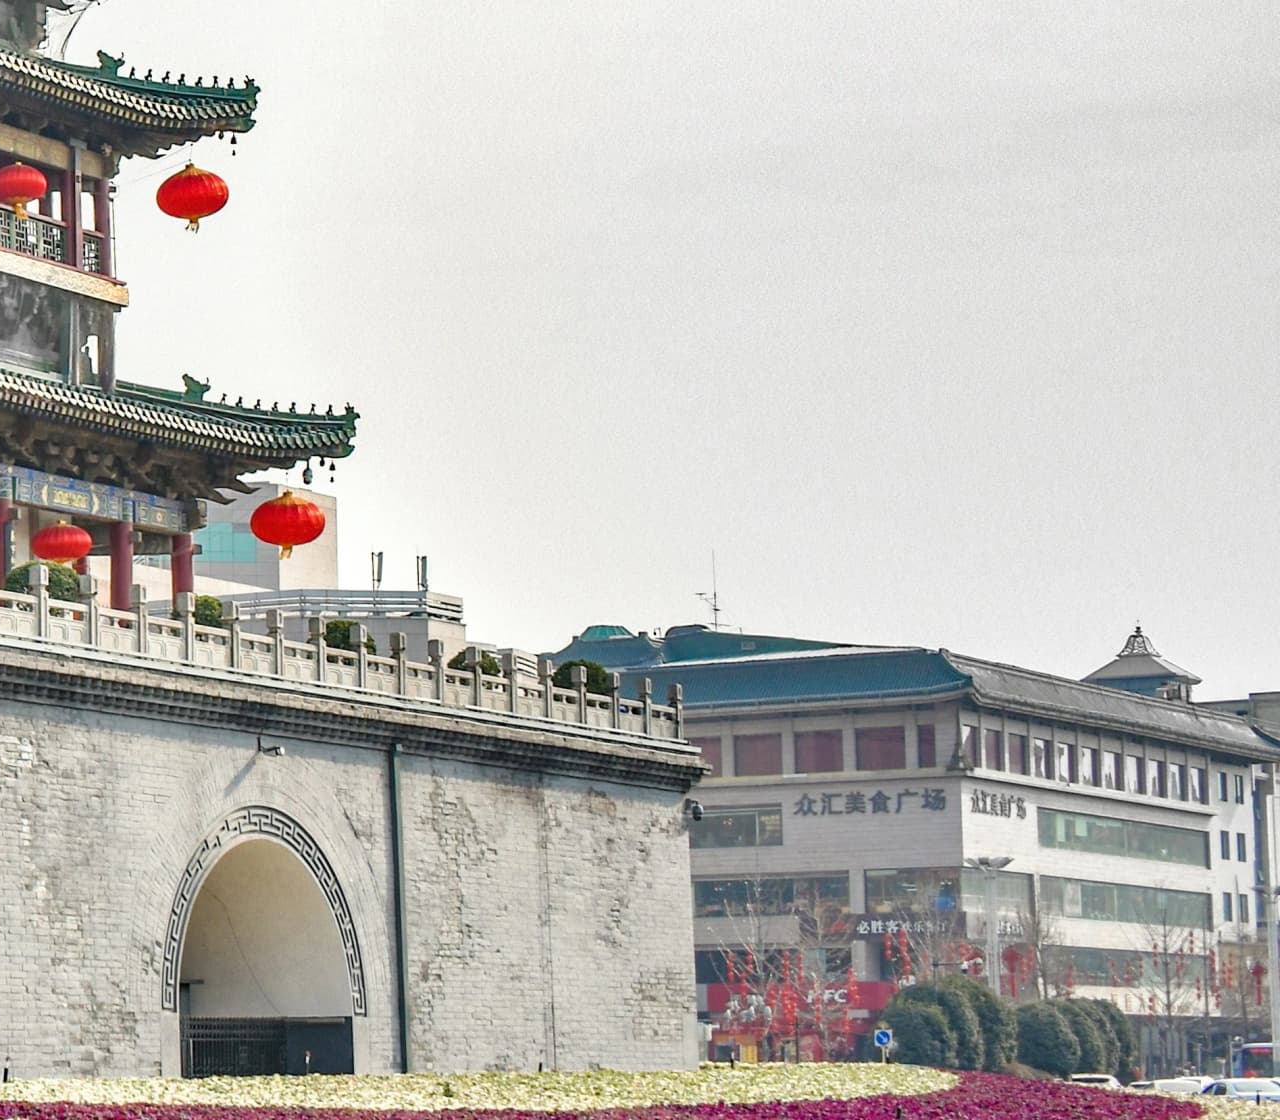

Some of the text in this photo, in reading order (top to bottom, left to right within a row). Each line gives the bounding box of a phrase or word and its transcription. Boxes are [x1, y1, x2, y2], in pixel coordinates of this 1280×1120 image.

[793, 788, 947, 816] 众汇美食广场
[970, 788, 1028, 820] 众汇美食广场
